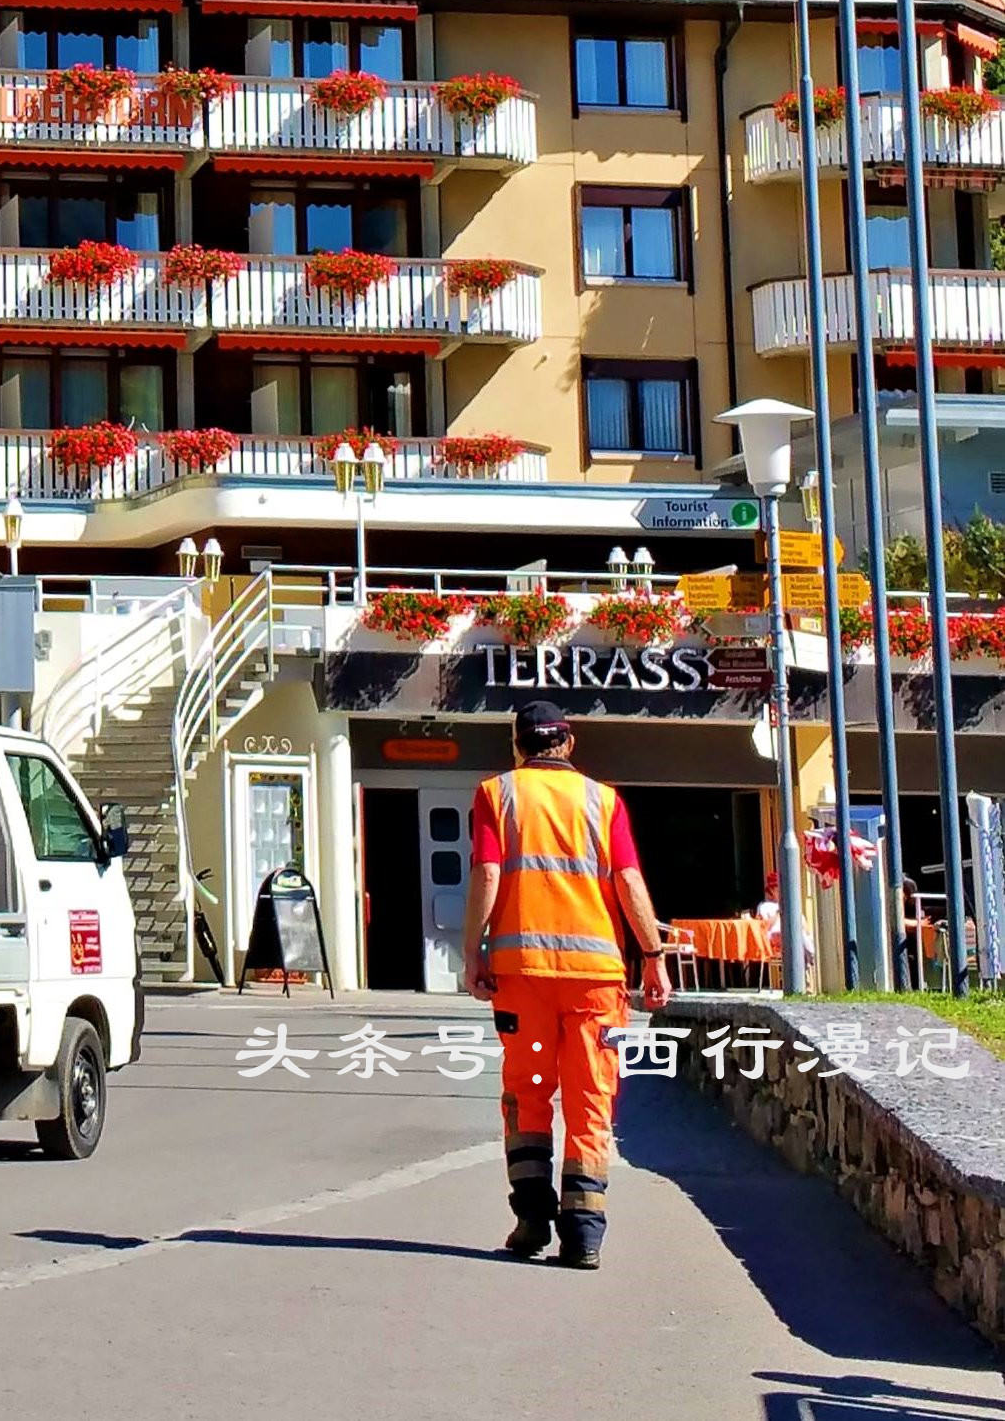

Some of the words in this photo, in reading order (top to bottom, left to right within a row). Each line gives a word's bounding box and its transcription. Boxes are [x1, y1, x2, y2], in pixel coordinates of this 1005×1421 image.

[665, 500, 708, 512] Tourist
[652, 516, 729, 528] Information
[476, 643, 716, 691] TERRASS
